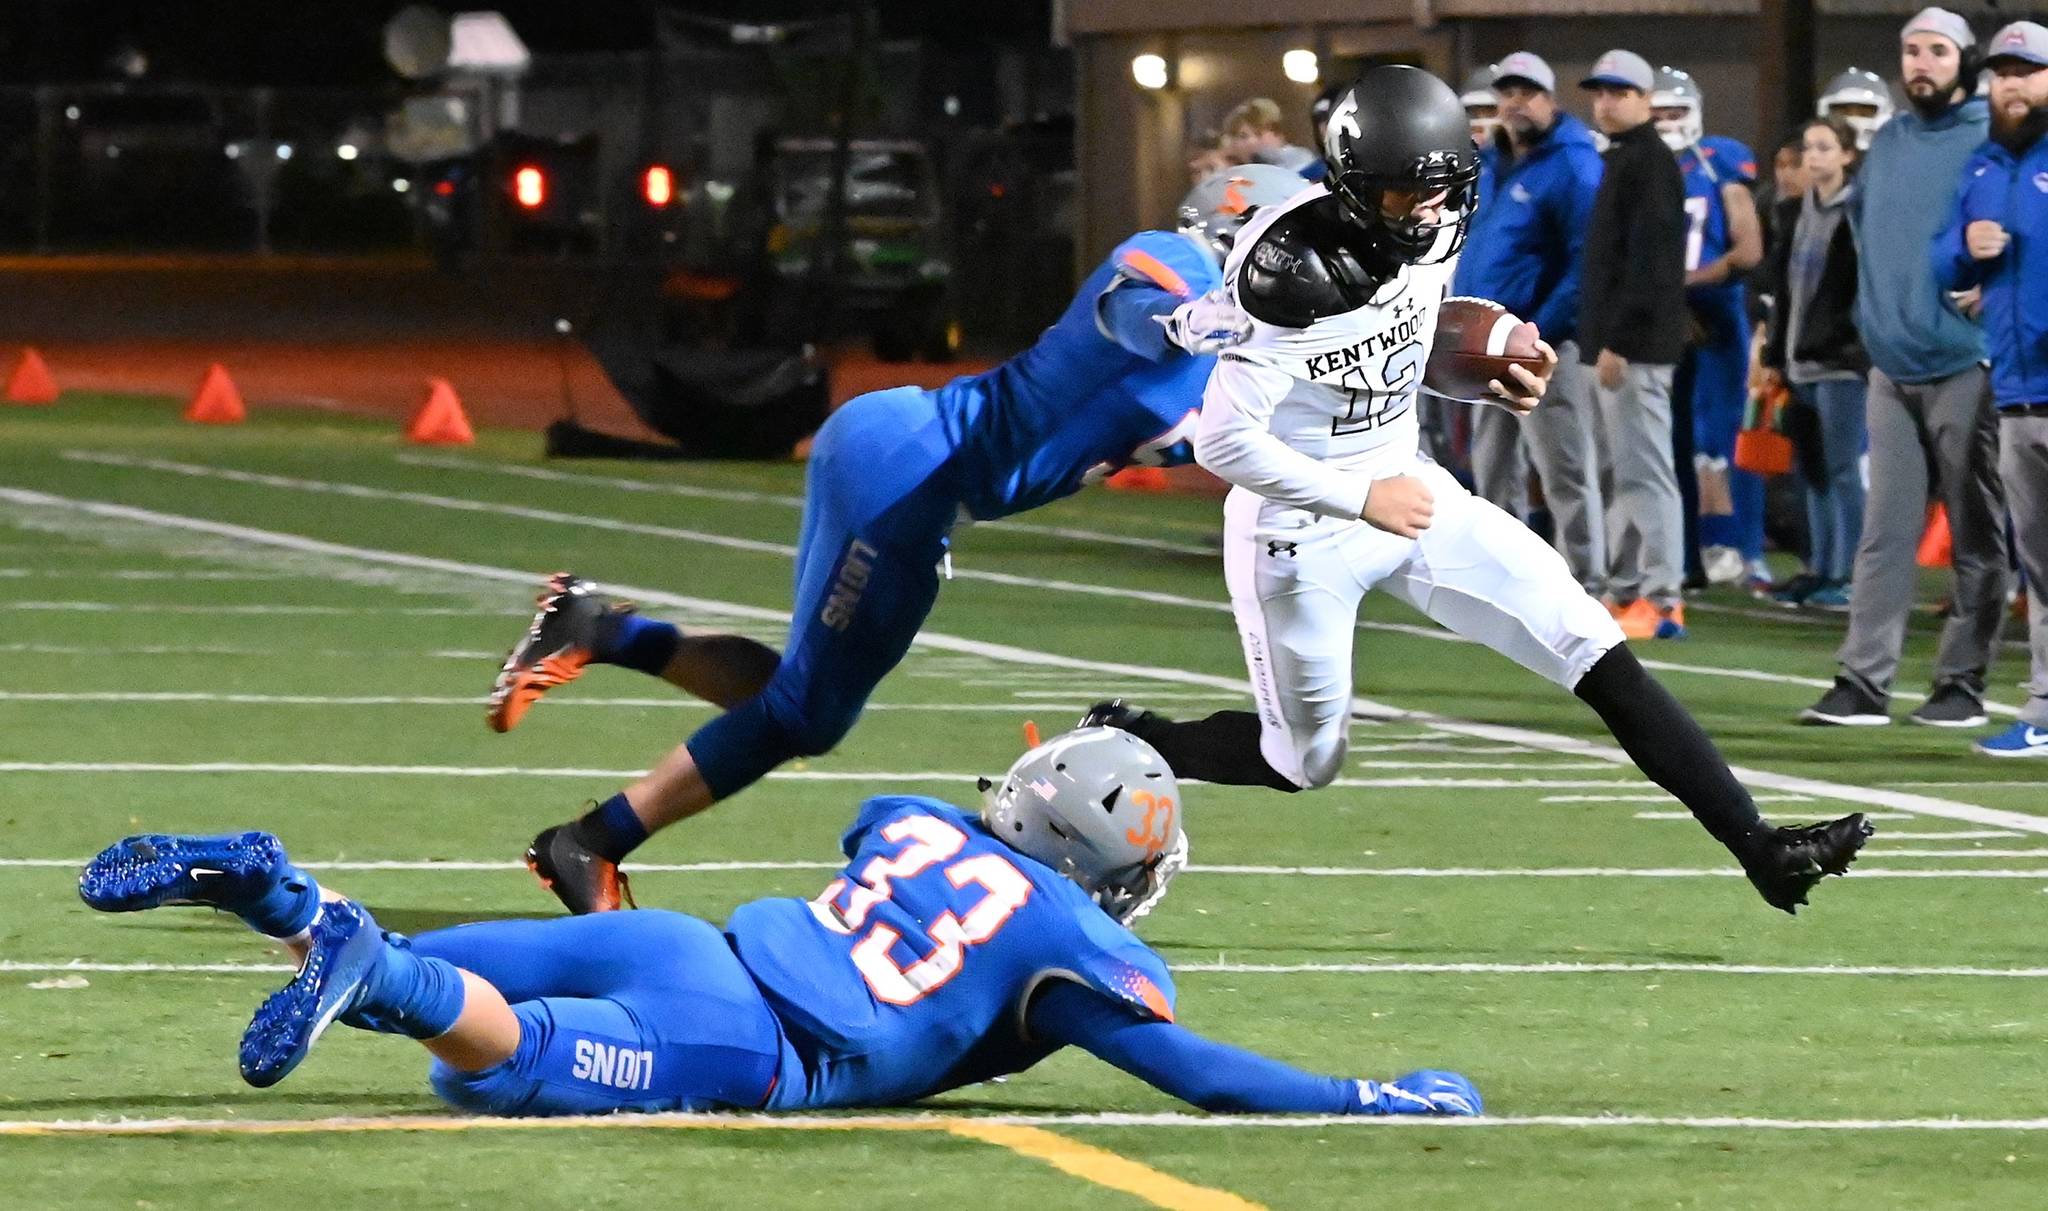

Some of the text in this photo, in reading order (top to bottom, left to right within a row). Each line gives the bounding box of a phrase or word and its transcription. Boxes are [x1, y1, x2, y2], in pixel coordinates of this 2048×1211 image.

[1305, 306, 1427, 381] KENTWOOD
[1331, 339, 1425, 437] 12
[821, 538, 879, 633] LIONS
[1126, 789, 1174, 863] 33
[805, 813, 1035, 1006] 33
[572, 1038, 654, 1091] LIONS
